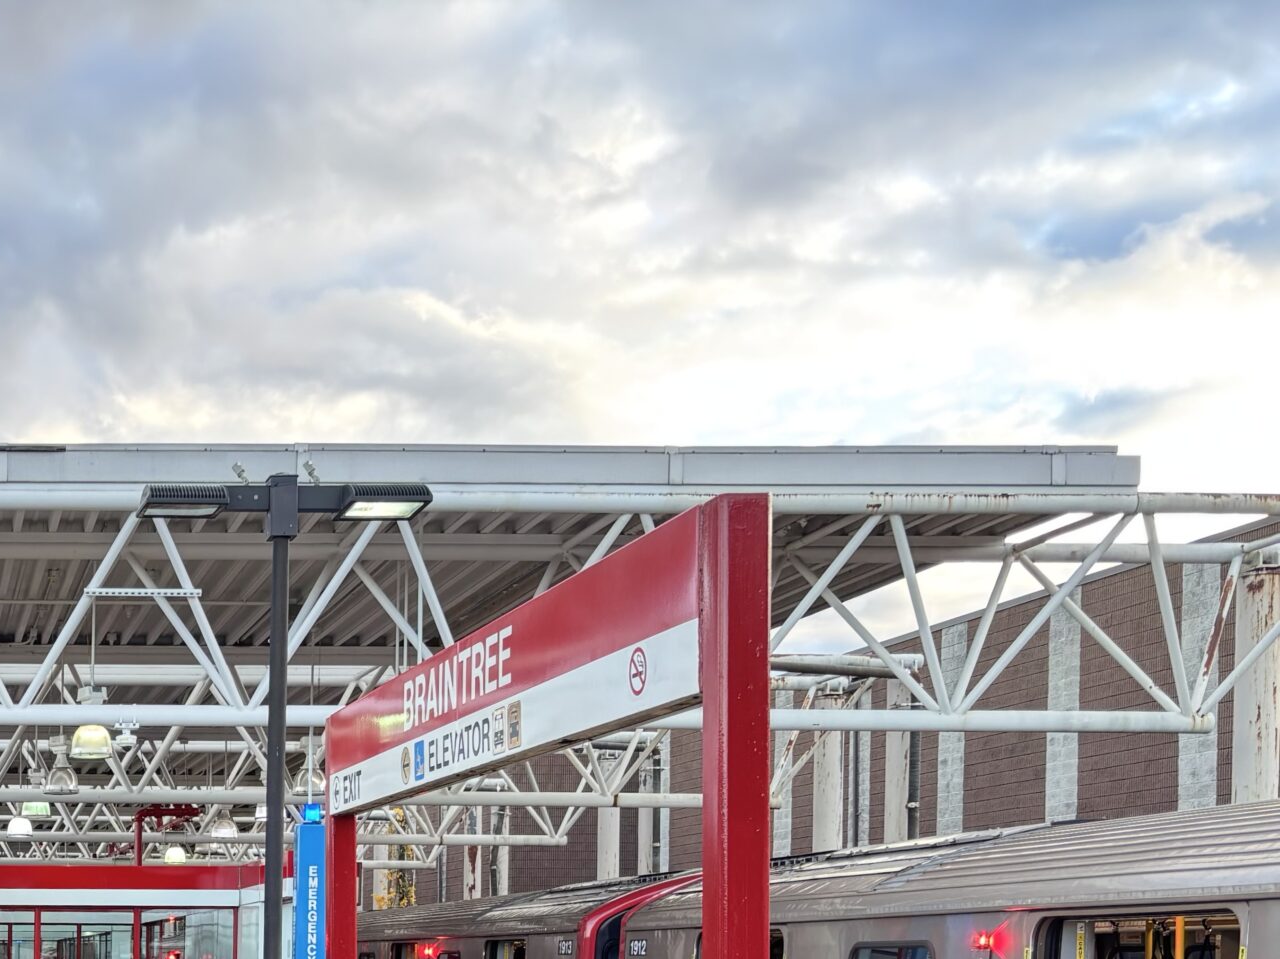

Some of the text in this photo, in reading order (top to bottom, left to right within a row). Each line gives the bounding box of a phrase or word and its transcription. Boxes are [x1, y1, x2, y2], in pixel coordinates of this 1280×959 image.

[403, 625, 513, 732] BRAINTREE
[428, 718, 491, 772] ELEVATOR
[343, 770, 362, 804] EXIT
[559, 941, 572, 954] 1913
[630, 941, 647, 955] 1912
